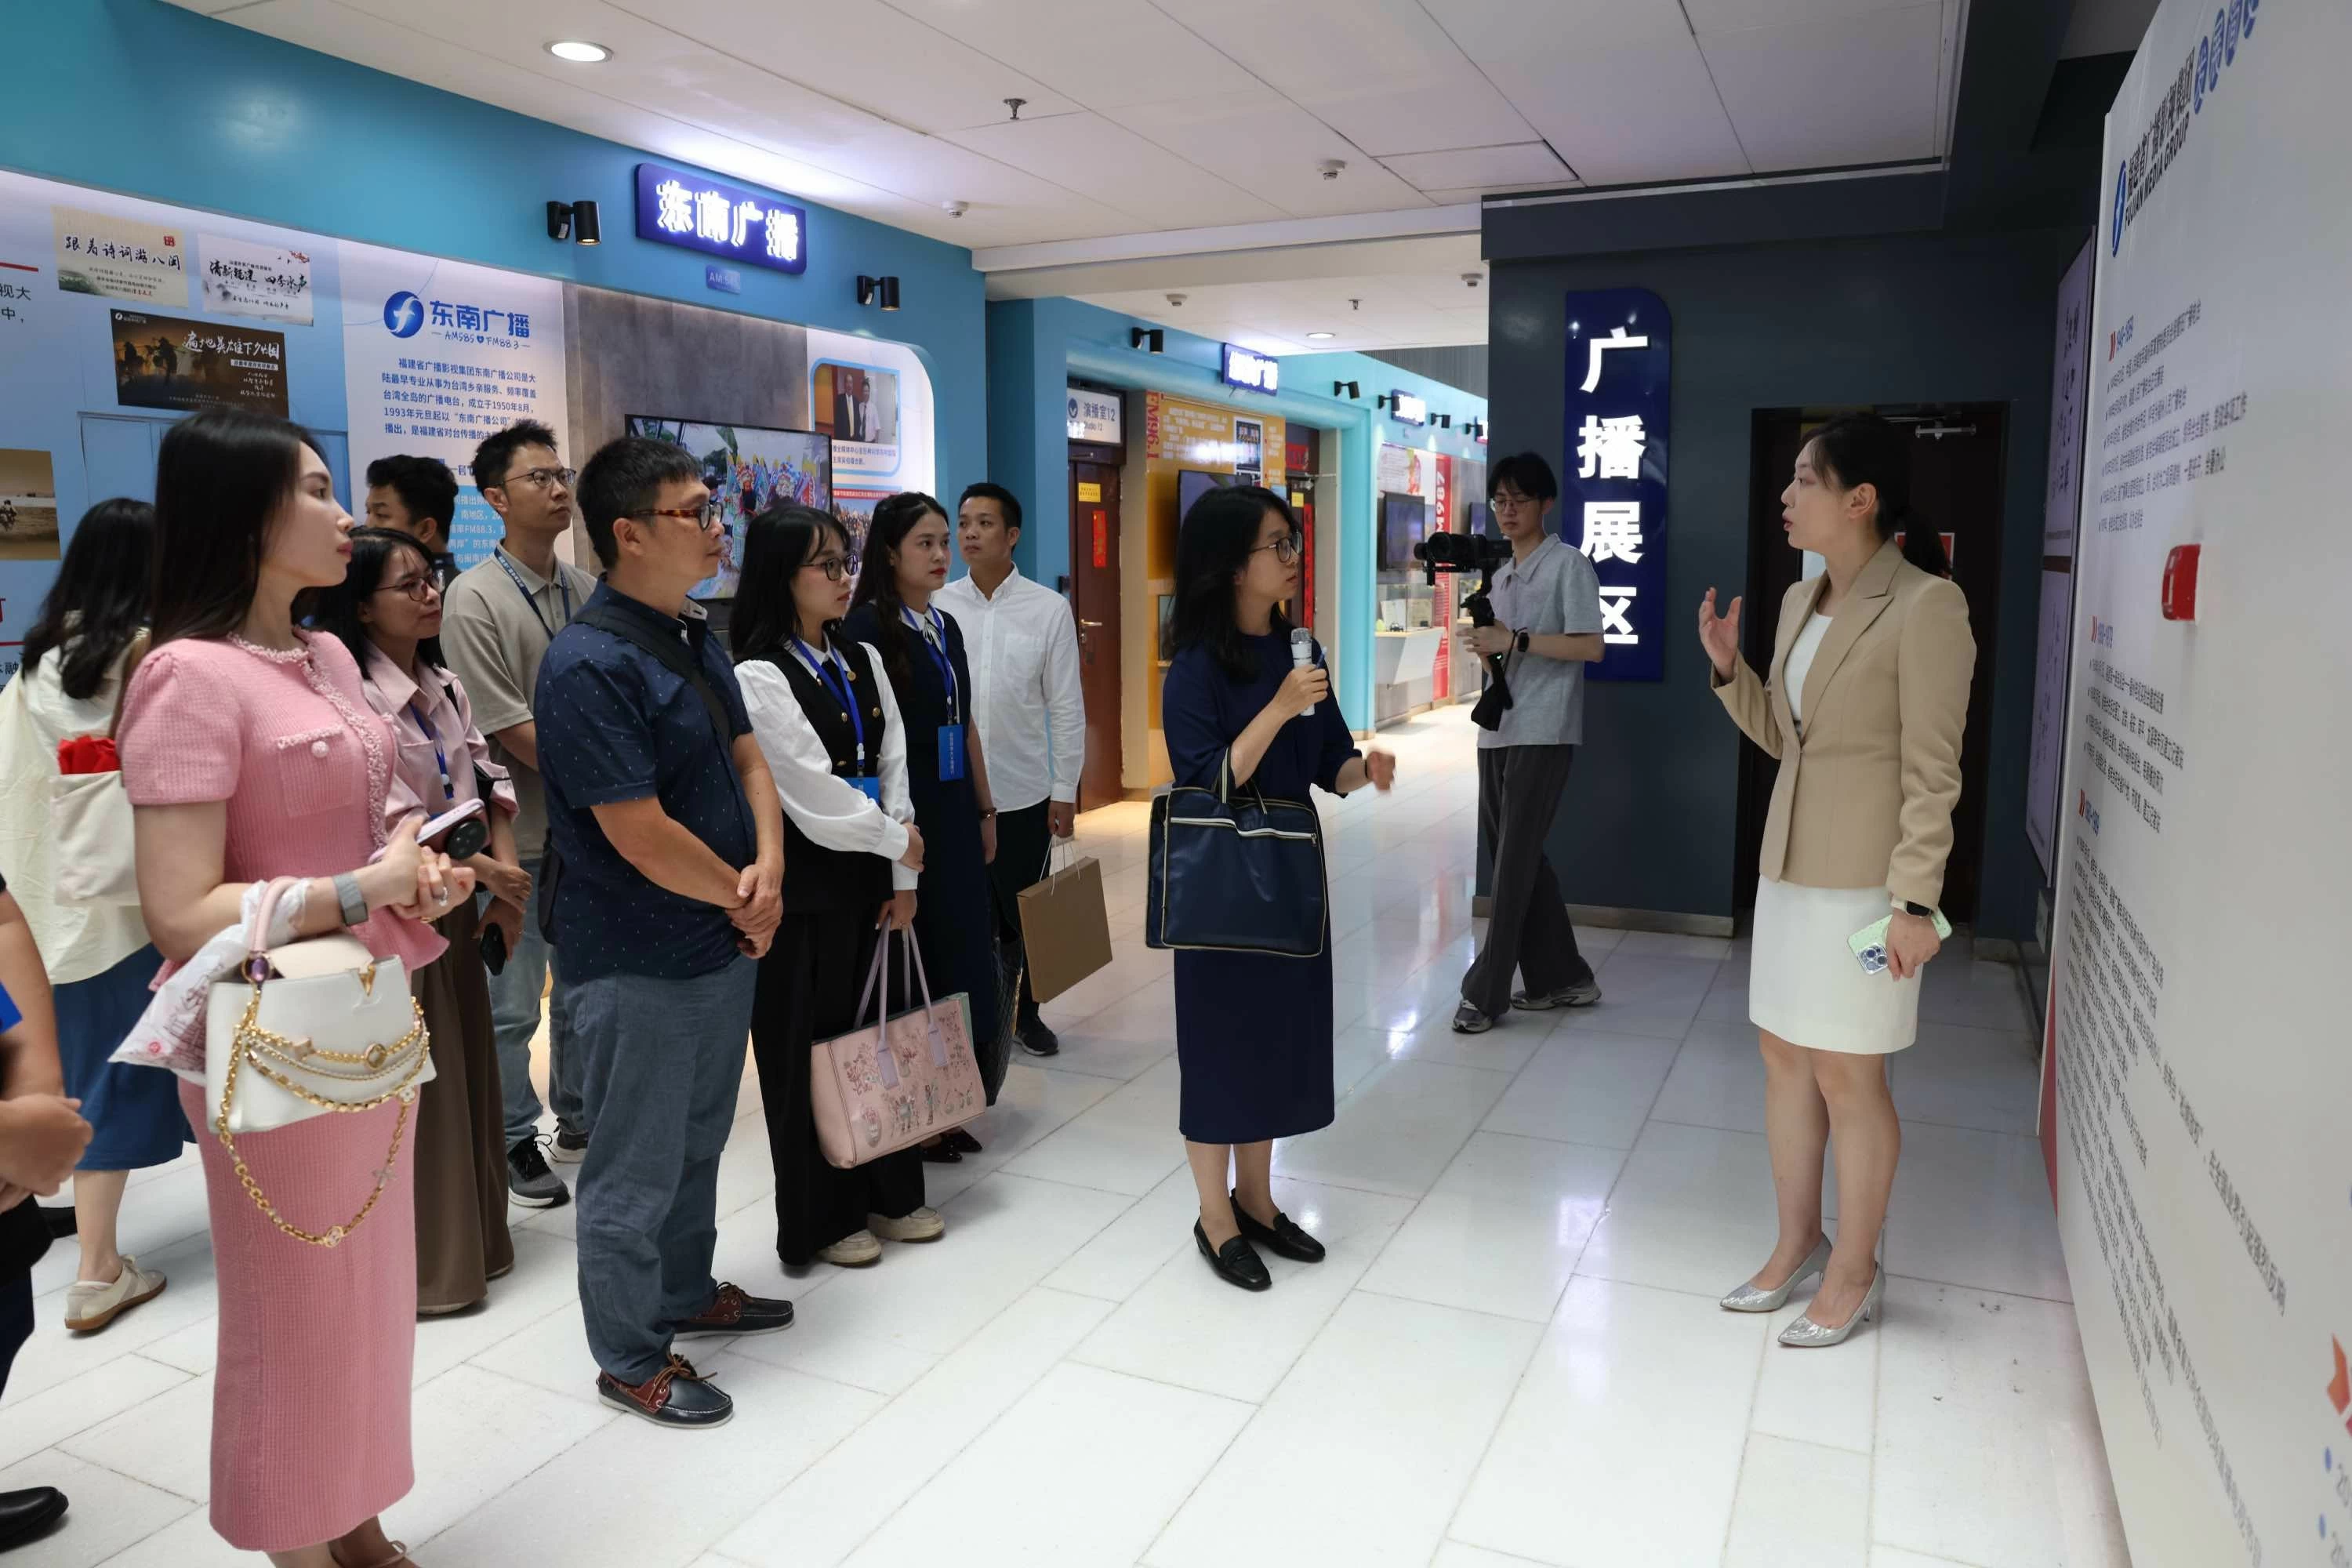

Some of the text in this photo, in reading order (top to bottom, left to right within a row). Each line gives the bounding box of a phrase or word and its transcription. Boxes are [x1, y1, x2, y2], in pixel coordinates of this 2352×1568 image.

[2125, 111, 2190, 230] FUJIAN MEDIA GROUP
[656, 180, 798, 261] 东南广播
[65, 235, 181, 270] 跟着诗词游八闽
[0, 283, 31, 301] 视大
[430, 300, 530, 338] 东南广播
[182, 329, 280, 360] 遍地英雄下夕烟
[445, 330, 519, 350] AM585 FM883
[398, 358, 536, 383] 福建省广播影视集团东南广播公司是大
[382, 372, 537, 398] 陆最早专业从事为台湾乡亲服务、频率覆盖
[383, 390, 535, 414] 台湾全岛的广播电台，成立于1950年8月，
[383, 407, 539, 427] 1993年元旦起以“东南广播公司”
[1146, 390, 1160, 459] FM96.1
[385, 423, 500, 440] 播出，是福建省对台传播的主
[1577, 326, 1649, 644] 广播展区
